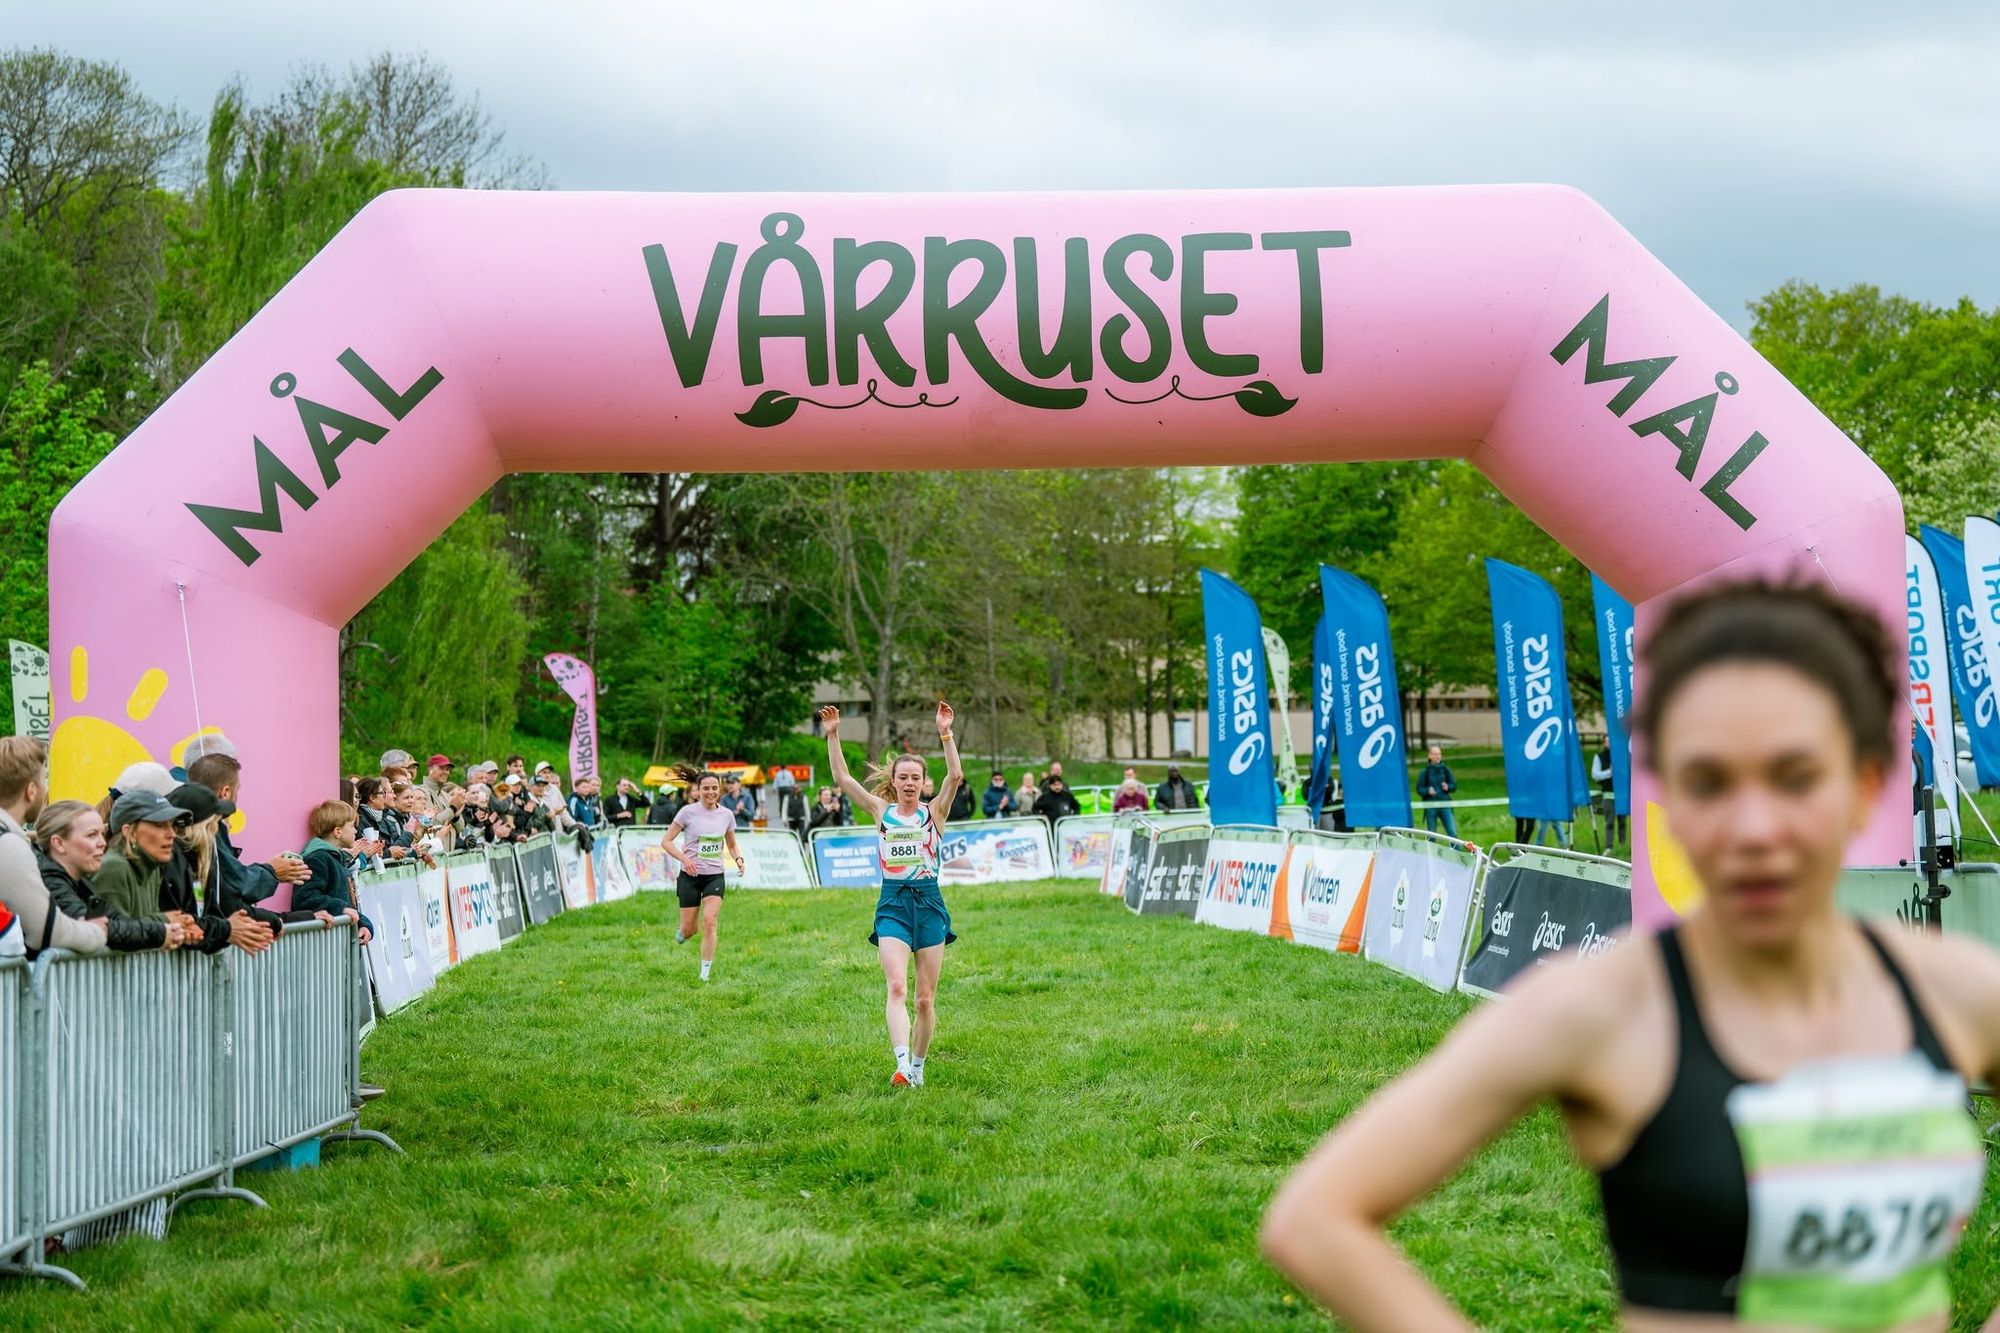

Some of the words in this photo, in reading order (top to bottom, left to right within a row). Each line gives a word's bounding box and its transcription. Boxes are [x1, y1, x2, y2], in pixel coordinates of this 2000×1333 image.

[642, 212, 1351, 409] VÅRRUSET
[1550, 292, 1770, 531] MÅL
[183, 347, 444, 567] MÅL
[701, 845, 719, 853] 8878
[891, 846, 916, 857] 8881
[941, 838, 967, 862] ers
[1213, 860, 1277, 909] INTERSPORT
[1786, 1193, 1953, 1267] 8879
